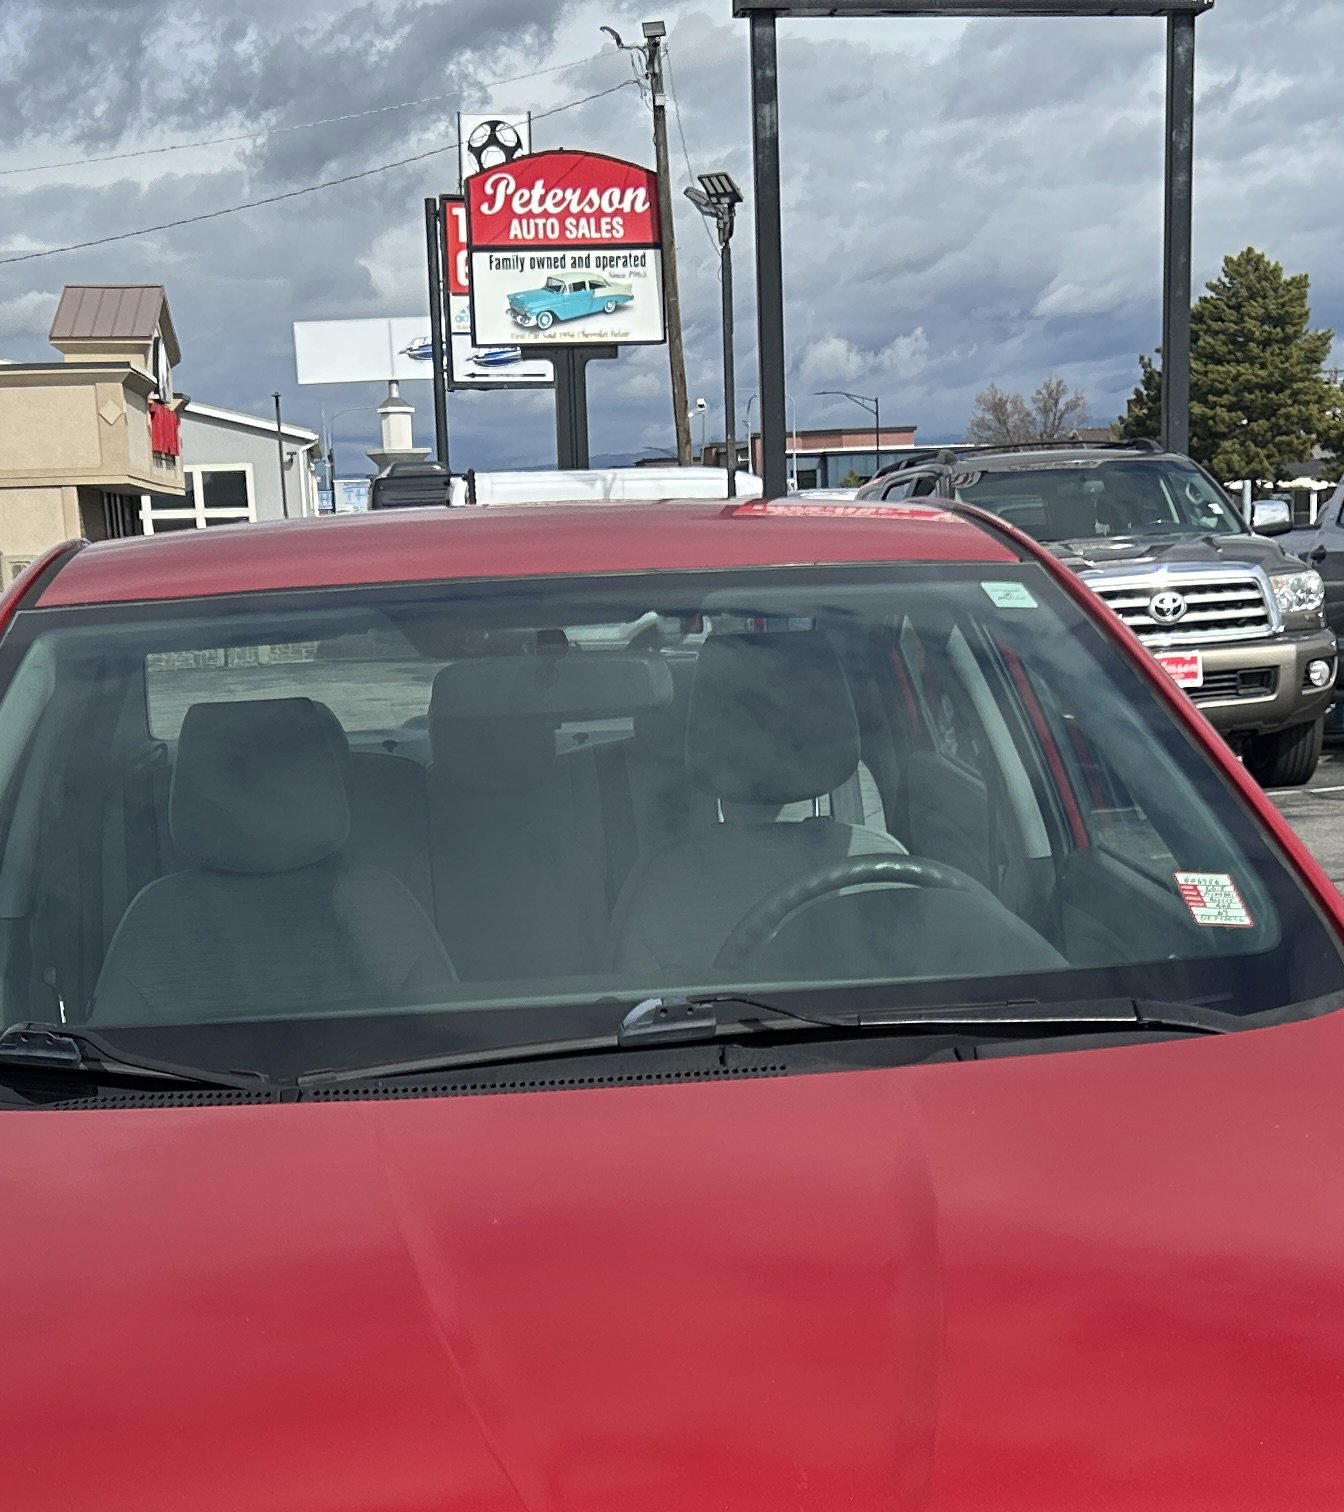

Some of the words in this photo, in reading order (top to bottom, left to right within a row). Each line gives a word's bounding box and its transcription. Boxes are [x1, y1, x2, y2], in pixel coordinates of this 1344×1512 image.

[480, 173, 651, 215] Peterson
[509, 218, 560, 240] AUTO
[565, 216, 625, 239] SALES
[489, 254, 526, 272] Family
[530, 253, 566, 270] owned
[570, 253, 591, 269] and
[595, 252, 647, 271] operated
